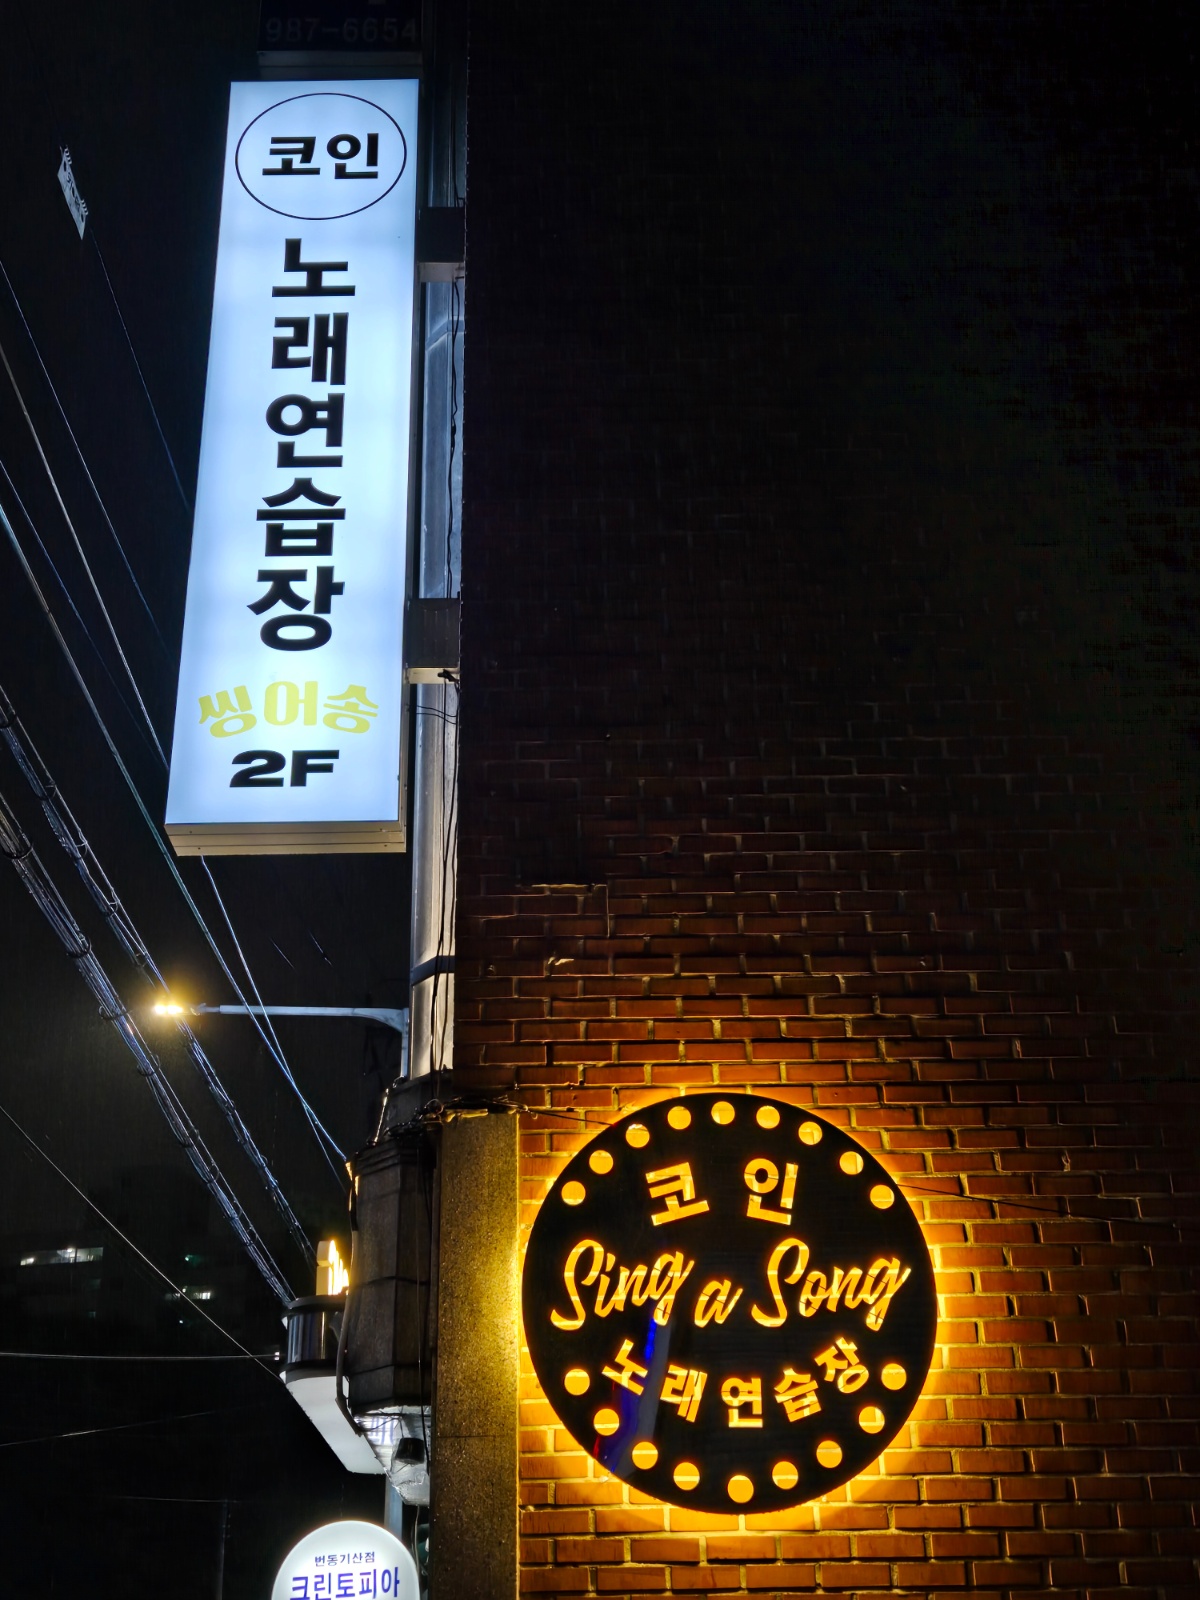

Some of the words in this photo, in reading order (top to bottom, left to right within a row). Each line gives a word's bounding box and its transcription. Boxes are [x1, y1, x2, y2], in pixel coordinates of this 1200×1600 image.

[265, 17, 417, 42] 987-6654
[262, 133, 379, 179] 코인
[247, 238, 356, 651] 노래연습장
[198, 680, 379, 738] 씽어송
[229, 749, 340, 788] 2F
[550, 1239, 695, 1330] Sing
[694, 1277, 743, 1328] a
[751, 1237, 912, 1331] Song
[601, 1337, 869, 1428] 노래연습장
[315, 1551, 376, 1567] 번동기산점
[290, 1566, 400, 1600] 크린토피아
